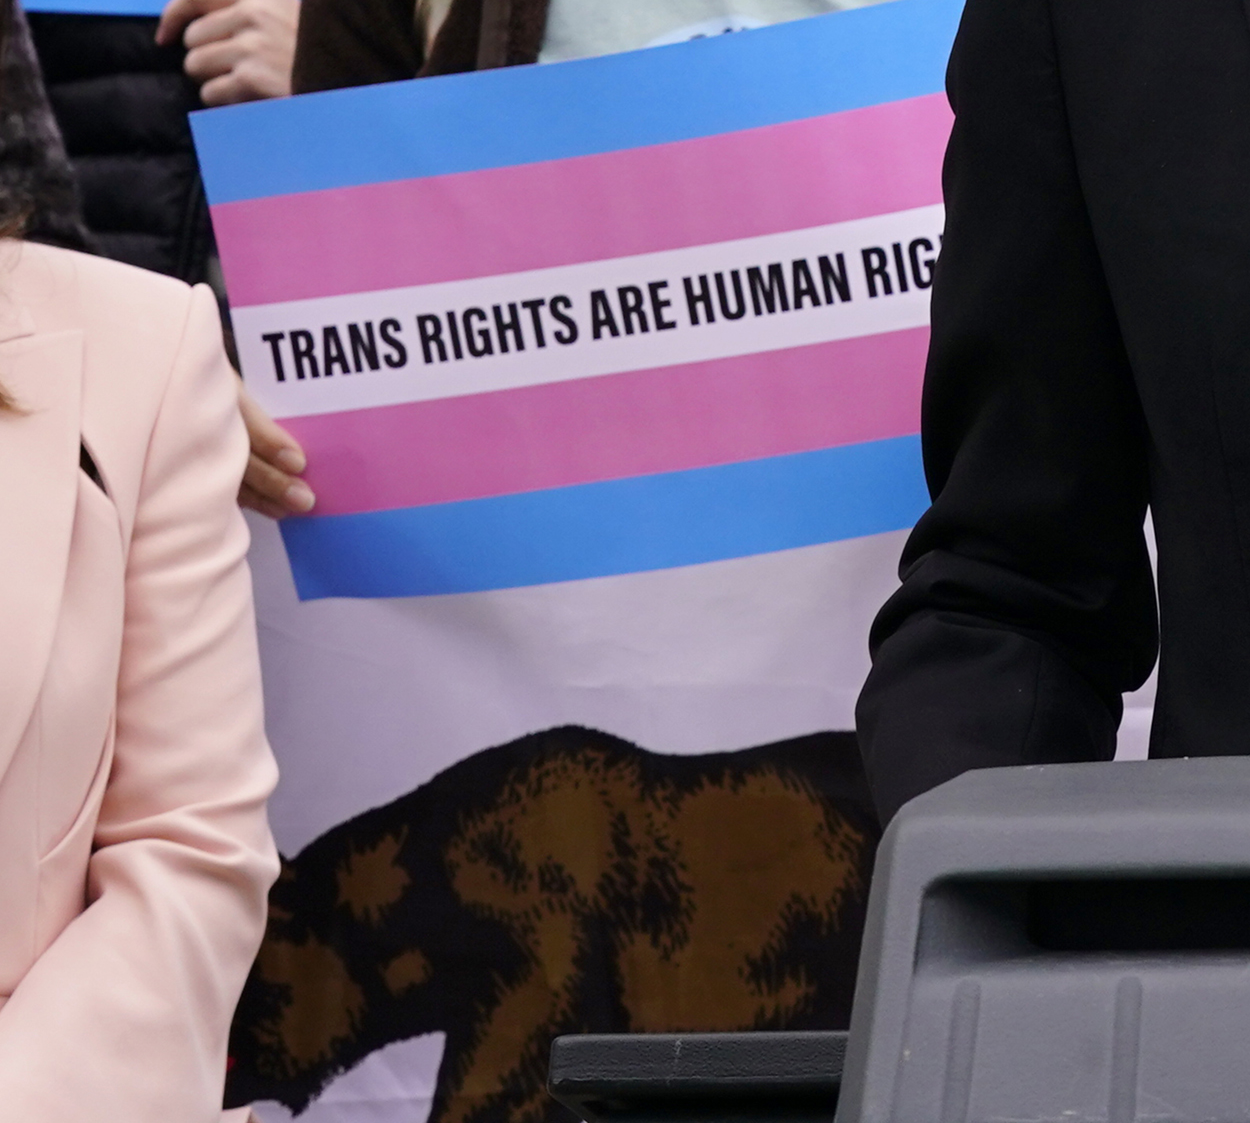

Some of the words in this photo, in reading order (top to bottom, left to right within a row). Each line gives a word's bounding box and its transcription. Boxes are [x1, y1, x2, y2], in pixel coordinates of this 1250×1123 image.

[261, 317, 408, 382] TRANS
[416, 294, 578, 364] RIGHTS
[589, 280, 677, 341] ARE
[682, 252, 852, 326] HUMAN
[861, 234, 944, 298] RIG
